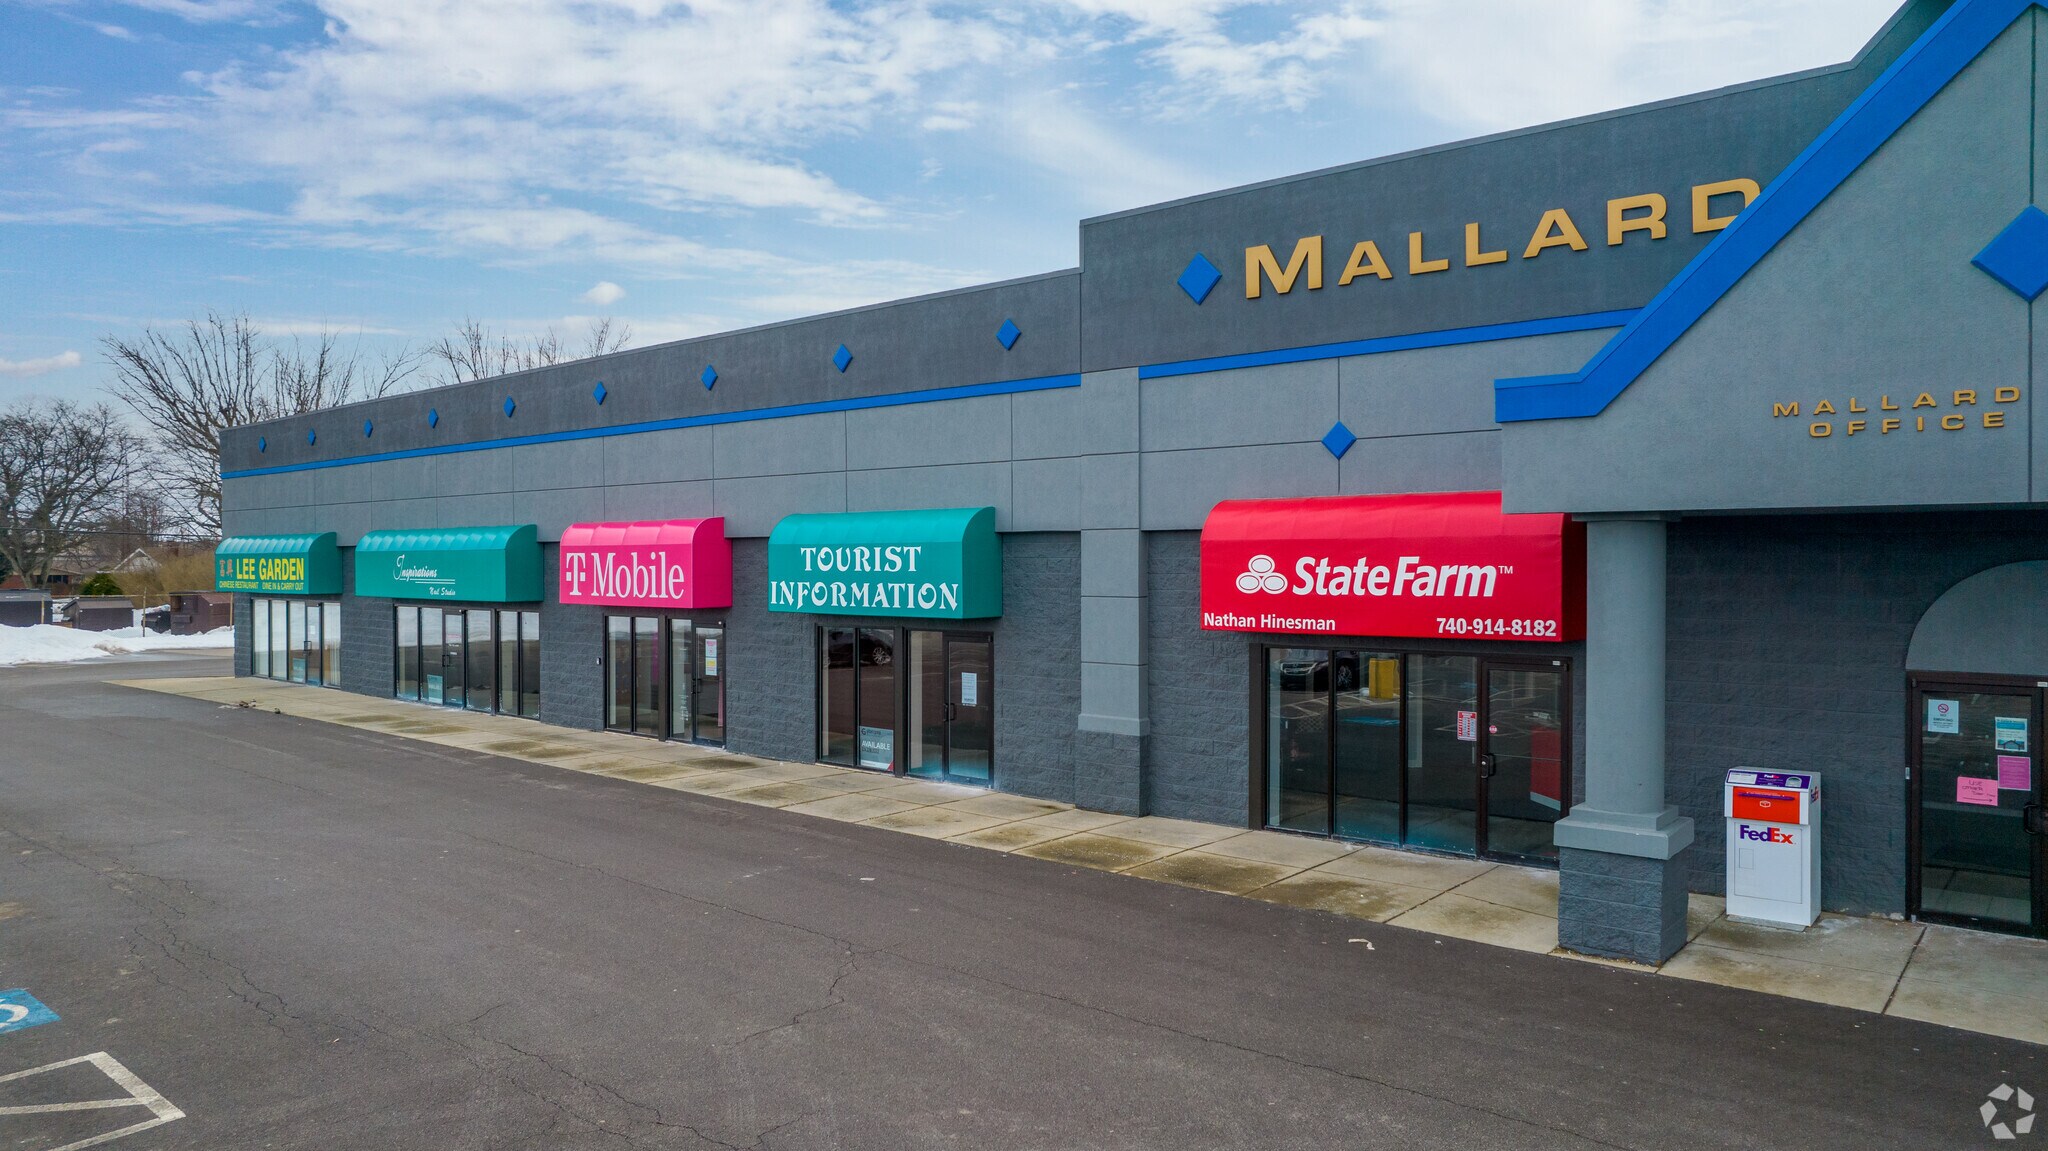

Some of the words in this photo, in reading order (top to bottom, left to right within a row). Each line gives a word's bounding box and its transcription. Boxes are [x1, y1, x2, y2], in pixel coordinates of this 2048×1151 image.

[1245, 177, 1761, 299] MALLARD
[1773, 387, 2020, 417] MALLARD
[1809, 411, 2004, 438] OFFICE
[236, 558, 256, 580] LEE
[259, 557, 304, 581] GARDEN
[393, 554, 437, 582] Inspirations
[800, 546, 921, 572] TOURIST
[591, 551, 685, 600] Mobile
[770, 580, 959, 611] INFORMATION
[1203, 612, 1256, 628] Nathan
[1260, 613, 1336, 631] Hinesman
[1436, 617, 1557, 637] 740-914-8182
[861, 740, 890, 750] AVAILABLE
[1740, 825, 1794, 844] FedEx
